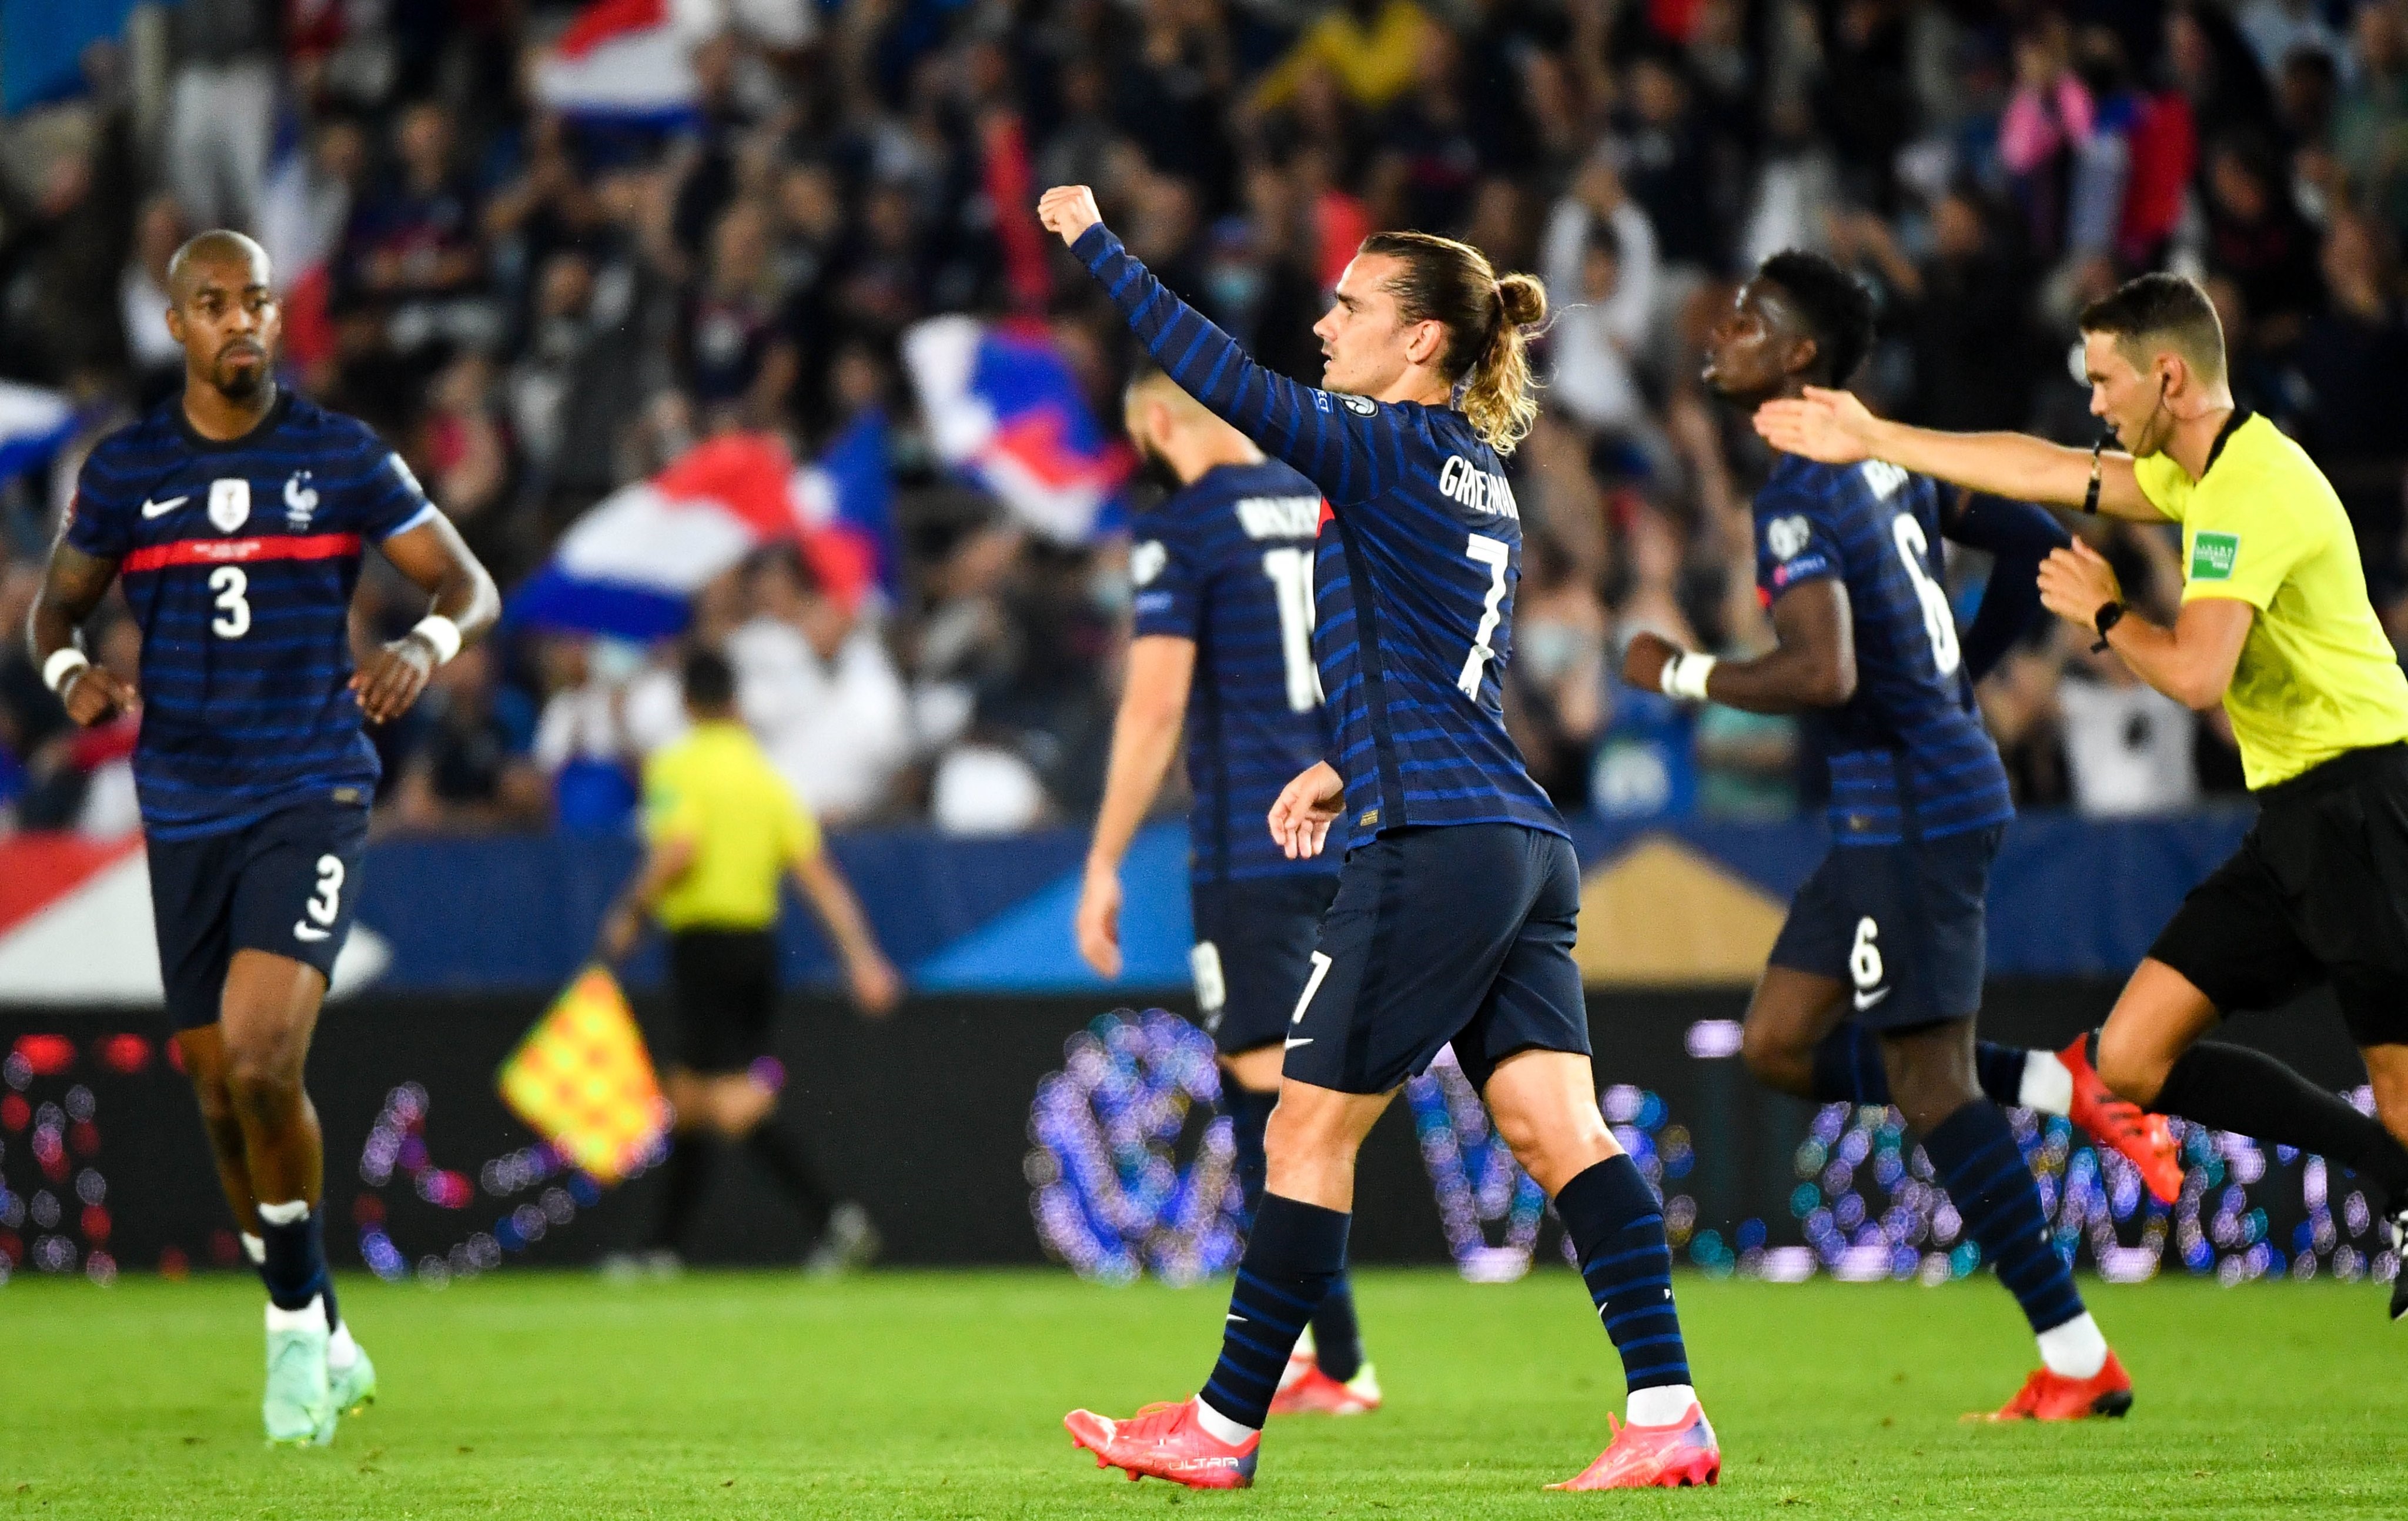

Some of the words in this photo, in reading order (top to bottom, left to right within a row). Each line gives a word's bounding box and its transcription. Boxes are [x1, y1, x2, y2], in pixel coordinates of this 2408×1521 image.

[208, 566, 251, 639] 3
[1457, 533, 1510, 702] 7
[1892, 512, 1961, 674] 6
[306, 854, 345, 926] 3
[1292, 950, 1333, 1025] 7
[1850, 915, 1882, 988] 6
[1169, 1456, 1240, 1470] ULTRA
